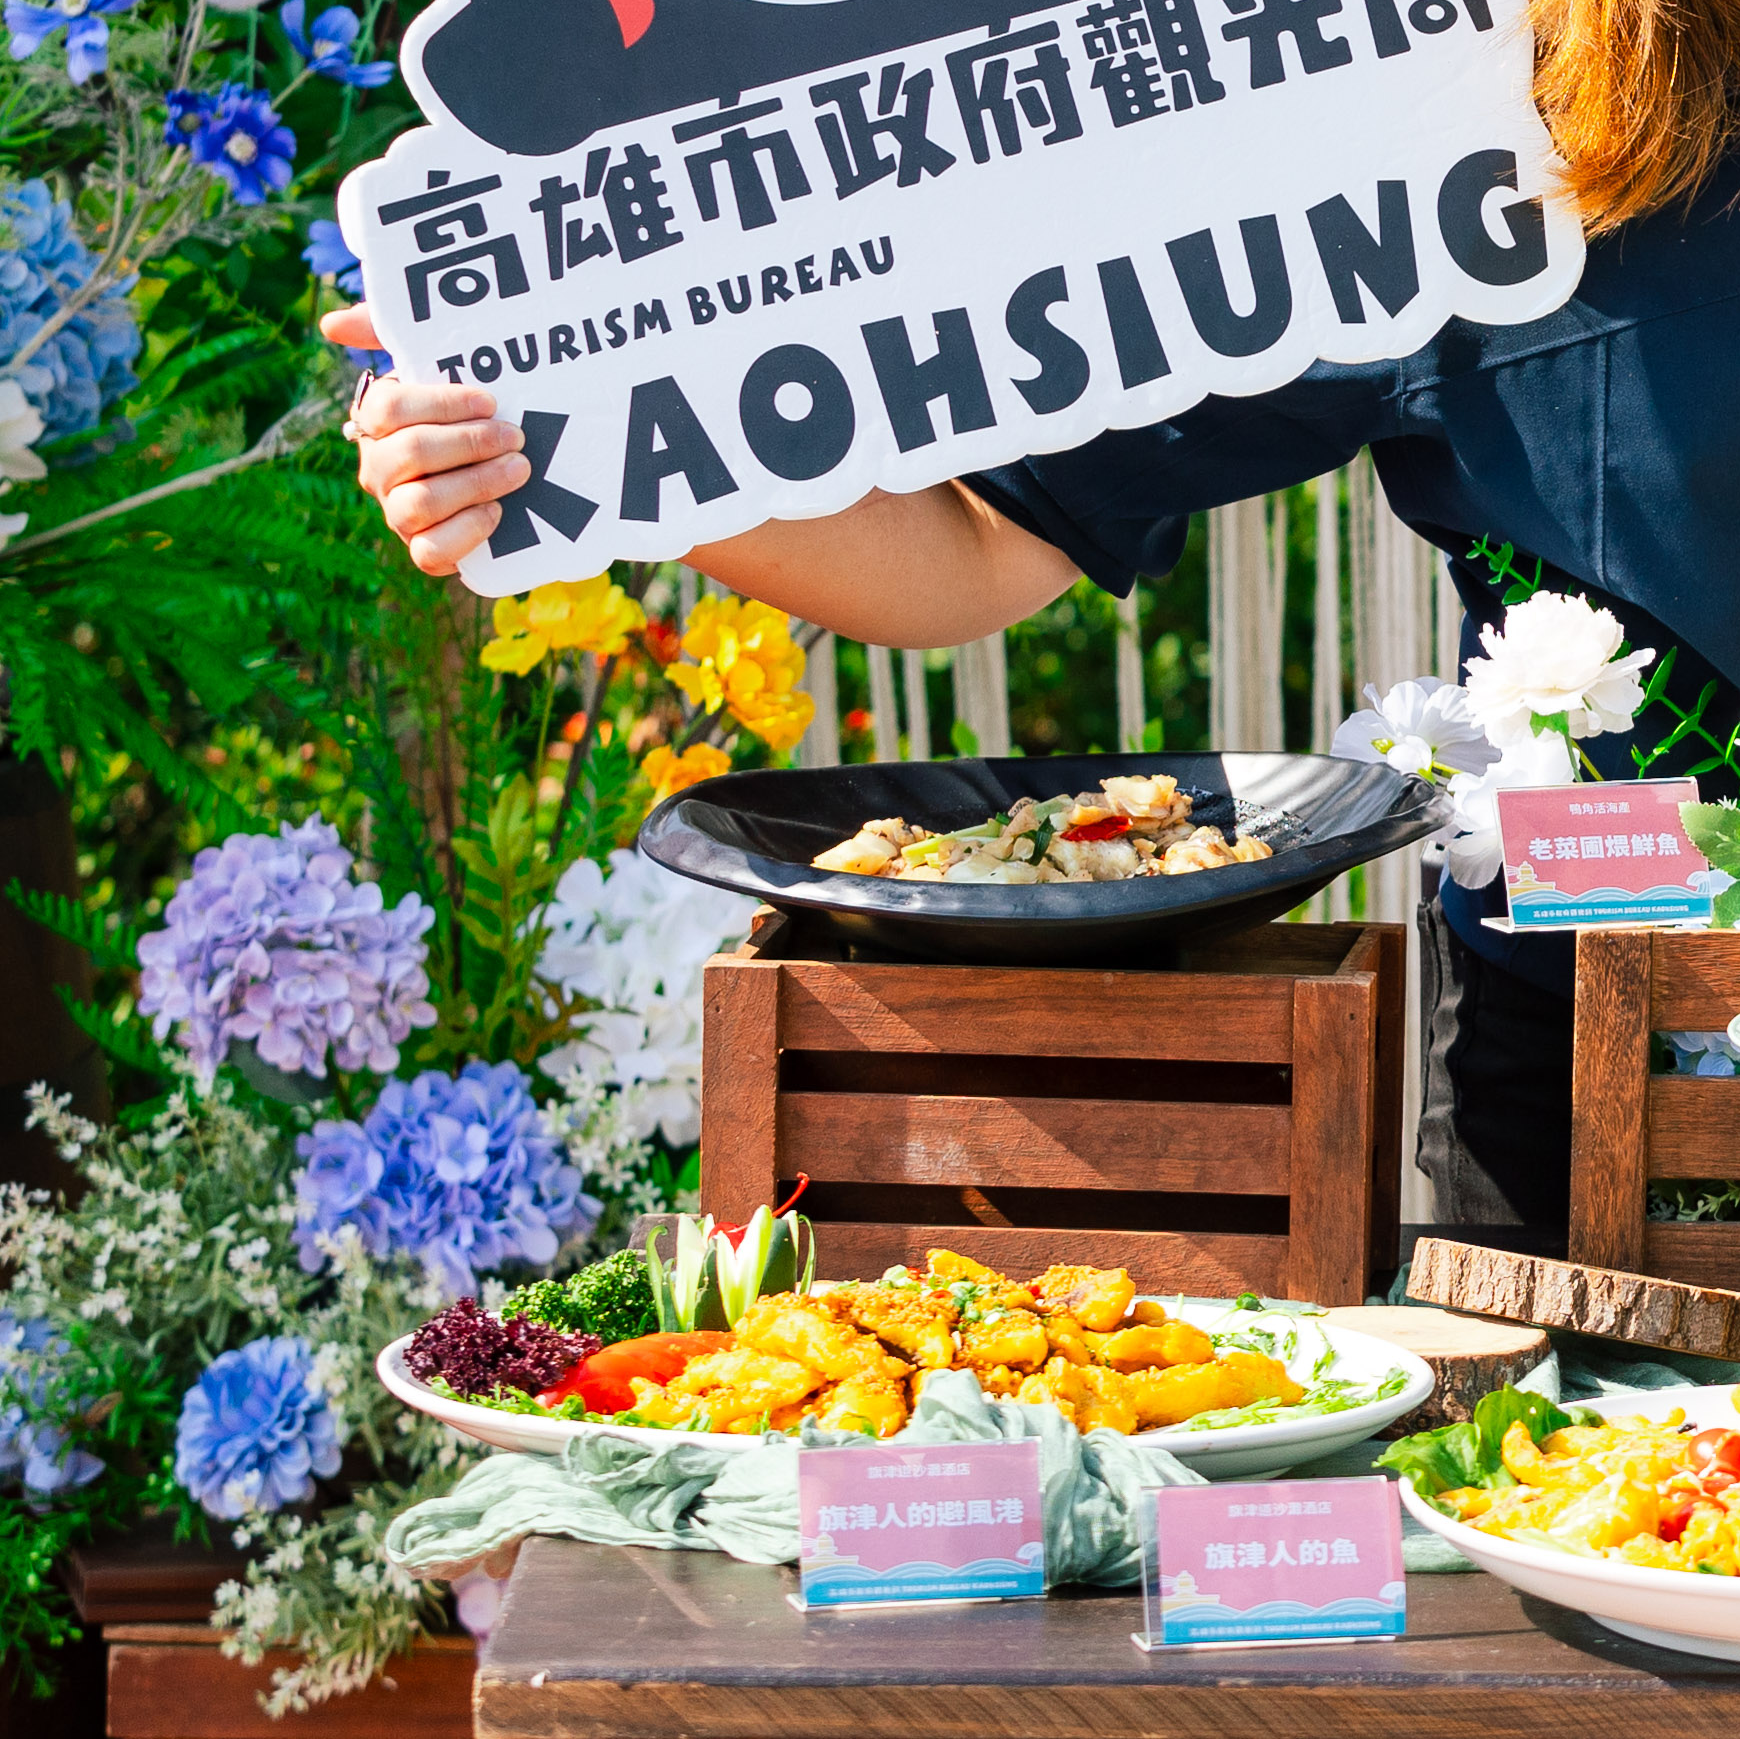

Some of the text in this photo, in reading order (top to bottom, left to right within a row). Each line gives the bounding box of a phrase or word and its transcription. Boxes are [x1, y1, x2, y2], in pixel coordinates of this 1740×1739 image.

[436, 235, 897, 386] TOURISM BUREAU
[490, 149, 1549, 559] KAOHSIUNG
[1528, 833, 1681, 861] 老菜圃煨鮮魚
[817, 1499, 1023, 1531] 旗津人的避風港
[1204, 1538, 1359, 1570] 旗津人的魚
